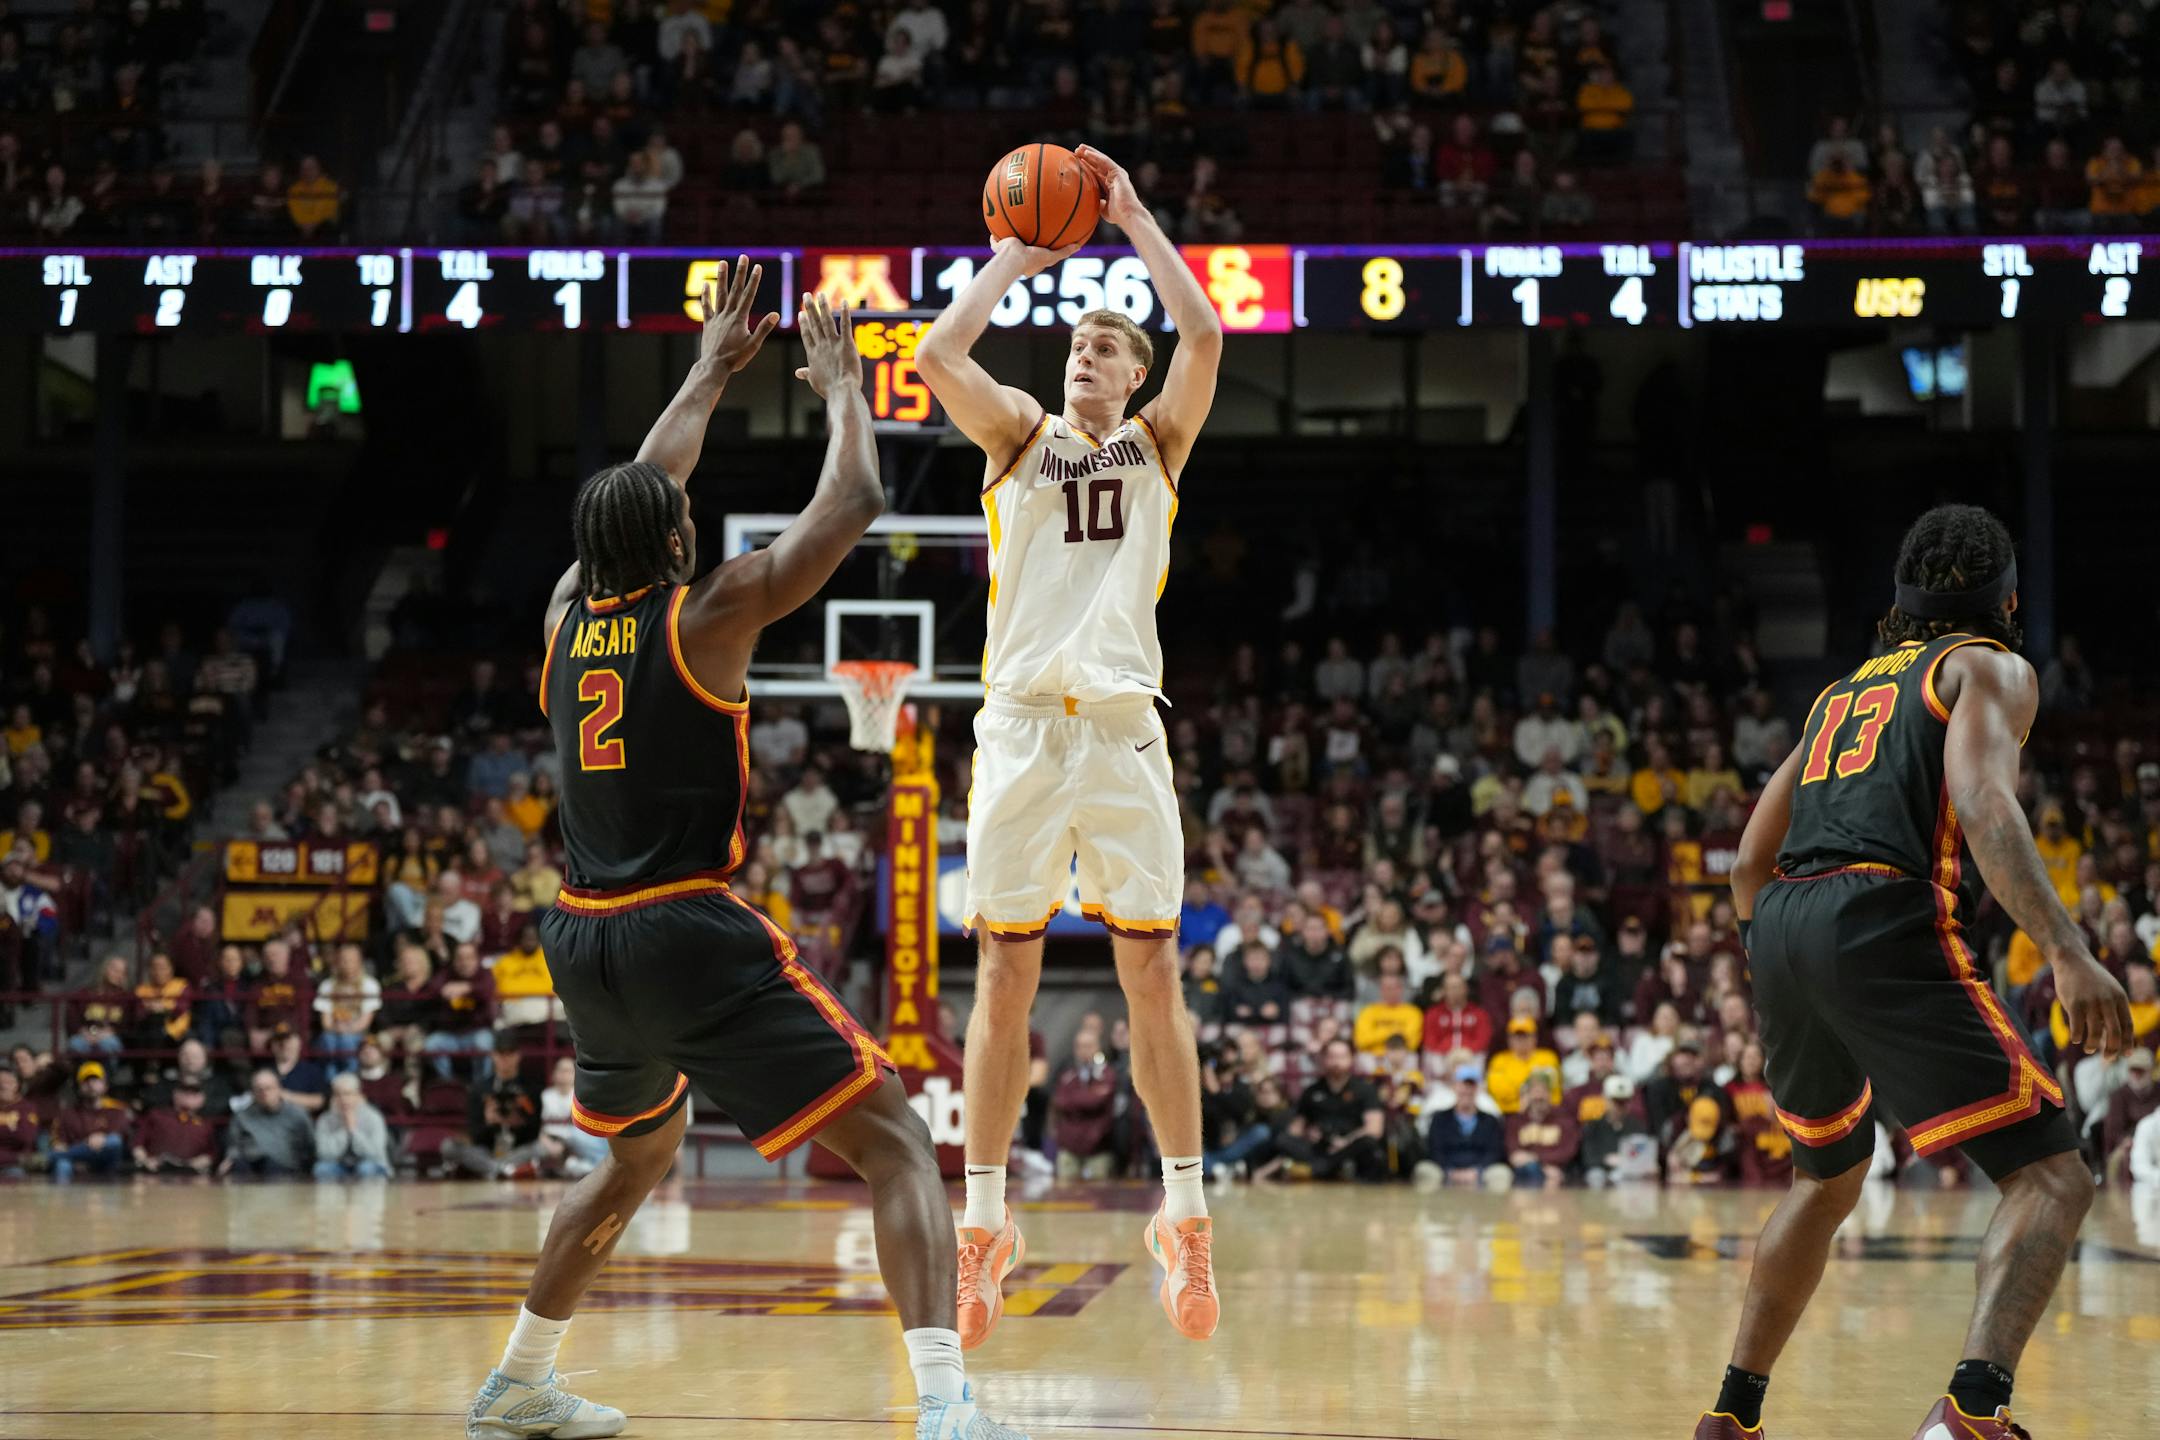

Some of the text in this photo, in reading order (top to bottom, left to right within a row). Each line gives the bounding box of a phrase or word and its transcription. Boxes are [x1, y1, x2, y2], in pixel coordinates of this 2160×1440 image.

[44, 254, 393, 285] STL AST BLK TO
[1690, 245, 1805, 281] HUSTLE
[1983, 242, 2142, 276] STL AST
[60, 289, 78, 326] 1
[155, 289, 185, 326] 2
[371, 289, 391, 326] 1
[446, 281, 582, 329] 4 1
[1361, 256, 1405, 321] 8
[1512, 276, 1647, 326] 1 4
[1692, 284, 1783, 321] STATS
[1854, 278, 1925, 317] USC
[2001, 277, 2130, 317] 1 2
[875, 360, 930, 421] 15
[1040, 440, 1147, 482] MINNESOTA
[1062, 478, 1124, 543] 10
[570, 616, 637, 658] AUSAR
[578, 668, 626, 771] 2
[1801, 682, 1899, 786] 13
[894, 793, 921, 1026] MINNESOTA
